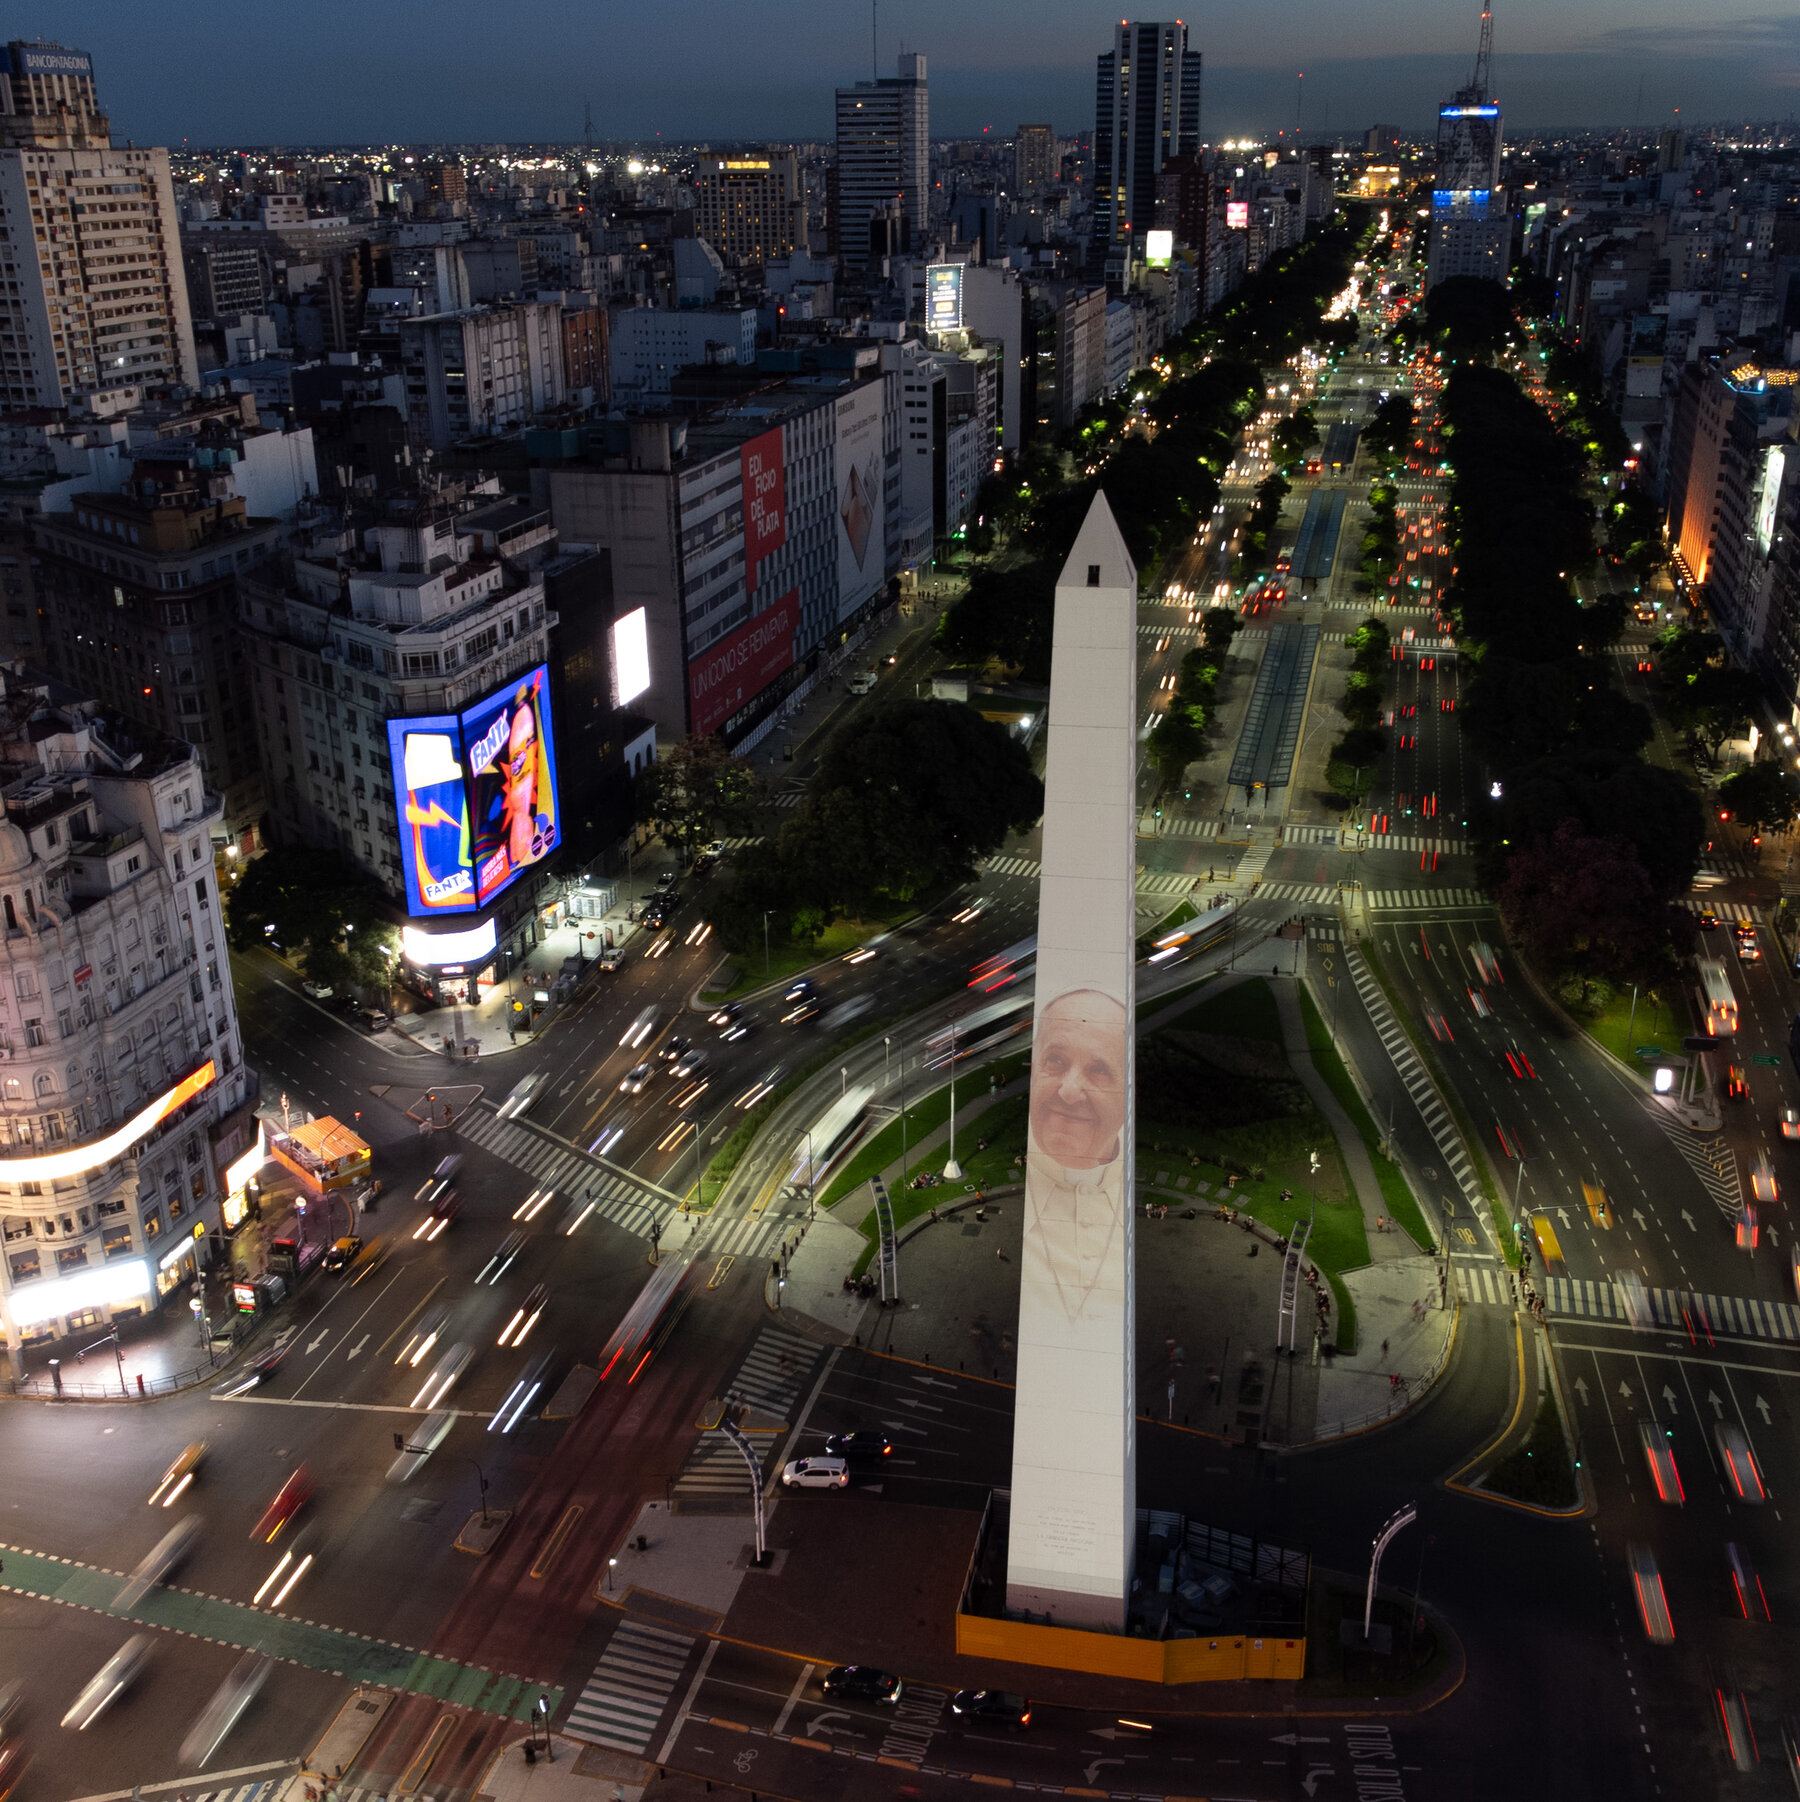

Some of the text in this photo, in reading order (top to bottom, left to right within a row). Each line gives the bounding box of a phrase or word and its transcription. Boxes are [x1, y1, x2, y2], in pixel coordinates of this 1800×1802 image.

[749, 452, 762, 478] EDI
[755, 467, 777, 497] FICIO
[750, 496, 765, 522] DEL
[757, 509, 780, 541] PLATA
[737, 638, 750, 666] SE
[749, 609, 789, 656] REINVENTA
[894, 1686, 948, 1724] SOLO
[877, 1723, 934, 1764] SOLO
[1343, 1724, 1397, 1760] SOLO
